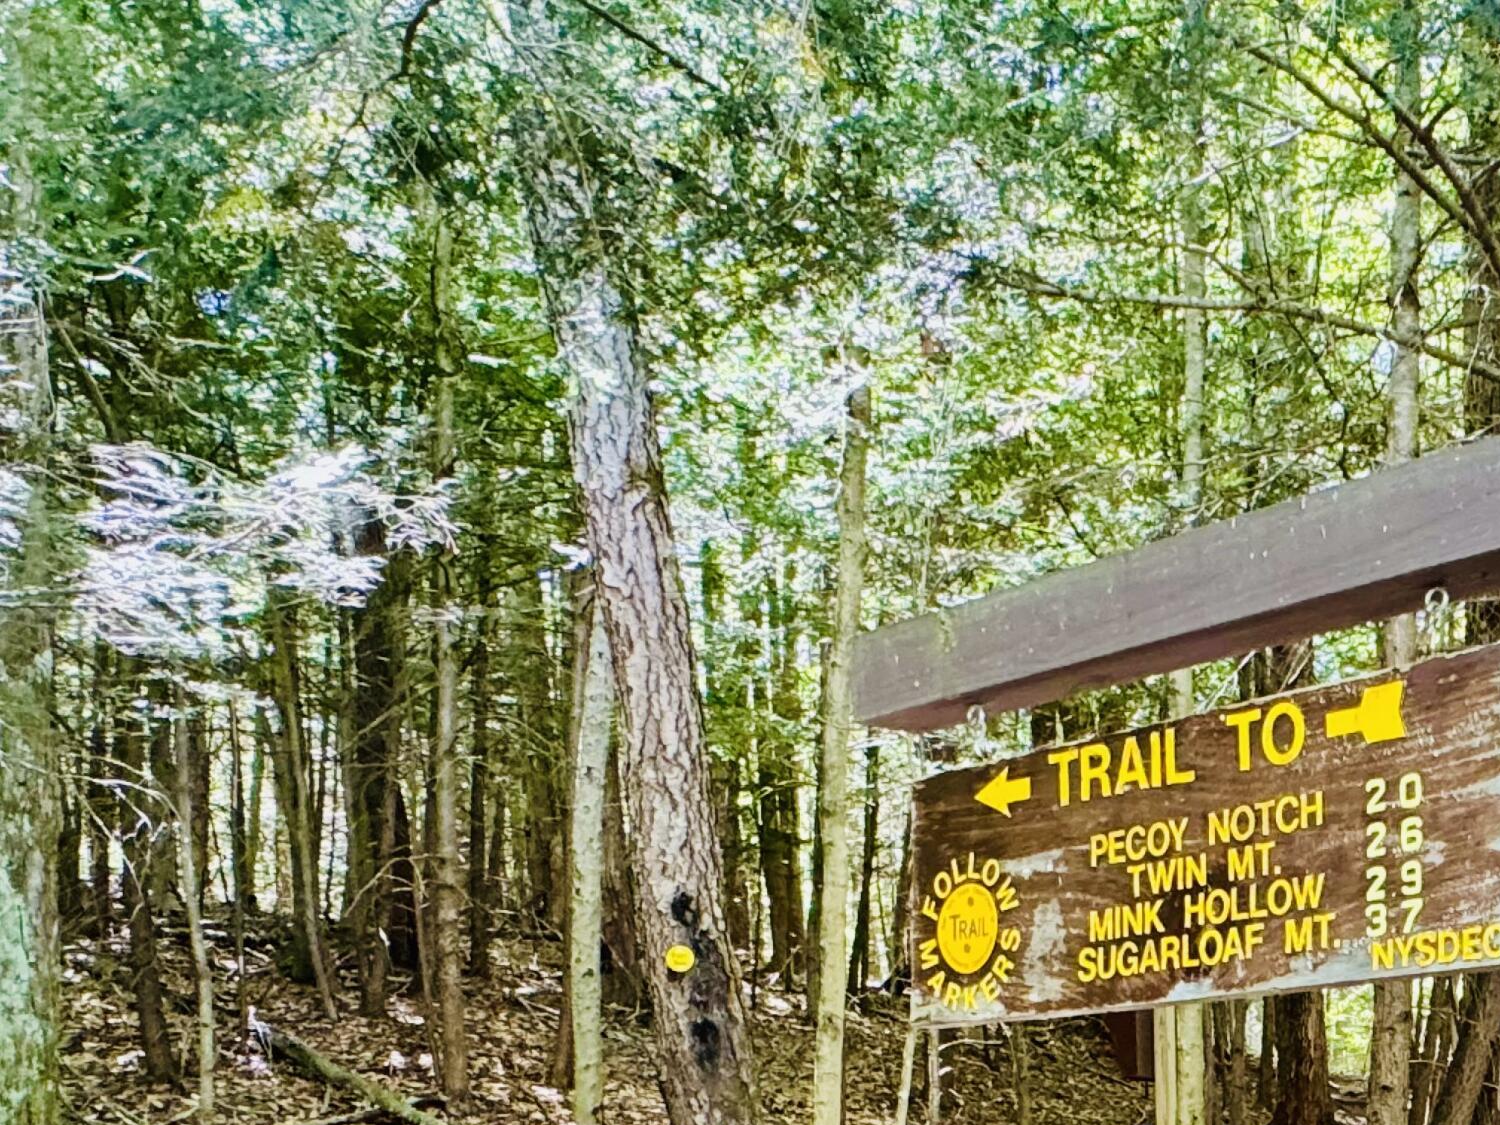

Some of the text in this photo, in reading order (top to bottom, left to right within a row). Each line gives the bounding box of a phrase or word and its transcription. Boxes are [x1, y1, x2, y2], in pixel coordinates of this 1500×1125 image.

[1047, 702, 1307, 808] TRAIL TO
[1090, 816, 1188, 868] PECOY
[1207, 790, 1324, 846] NOTCH
[920, 851, 1020, 922] FOLLOW
[1126, 852, 1208, 898] TWIN
[1227, 840, 1282, 882] MT.
[1089, 898, 1166, 943] MINK
[1183, 872, 1326, 929] HOLLOW
[918, 927, 1022, 1012] MARKERS
[1077, 922, 1265, 983] SUGARLOAF
[1284, 911, 1342, 954] MT.
